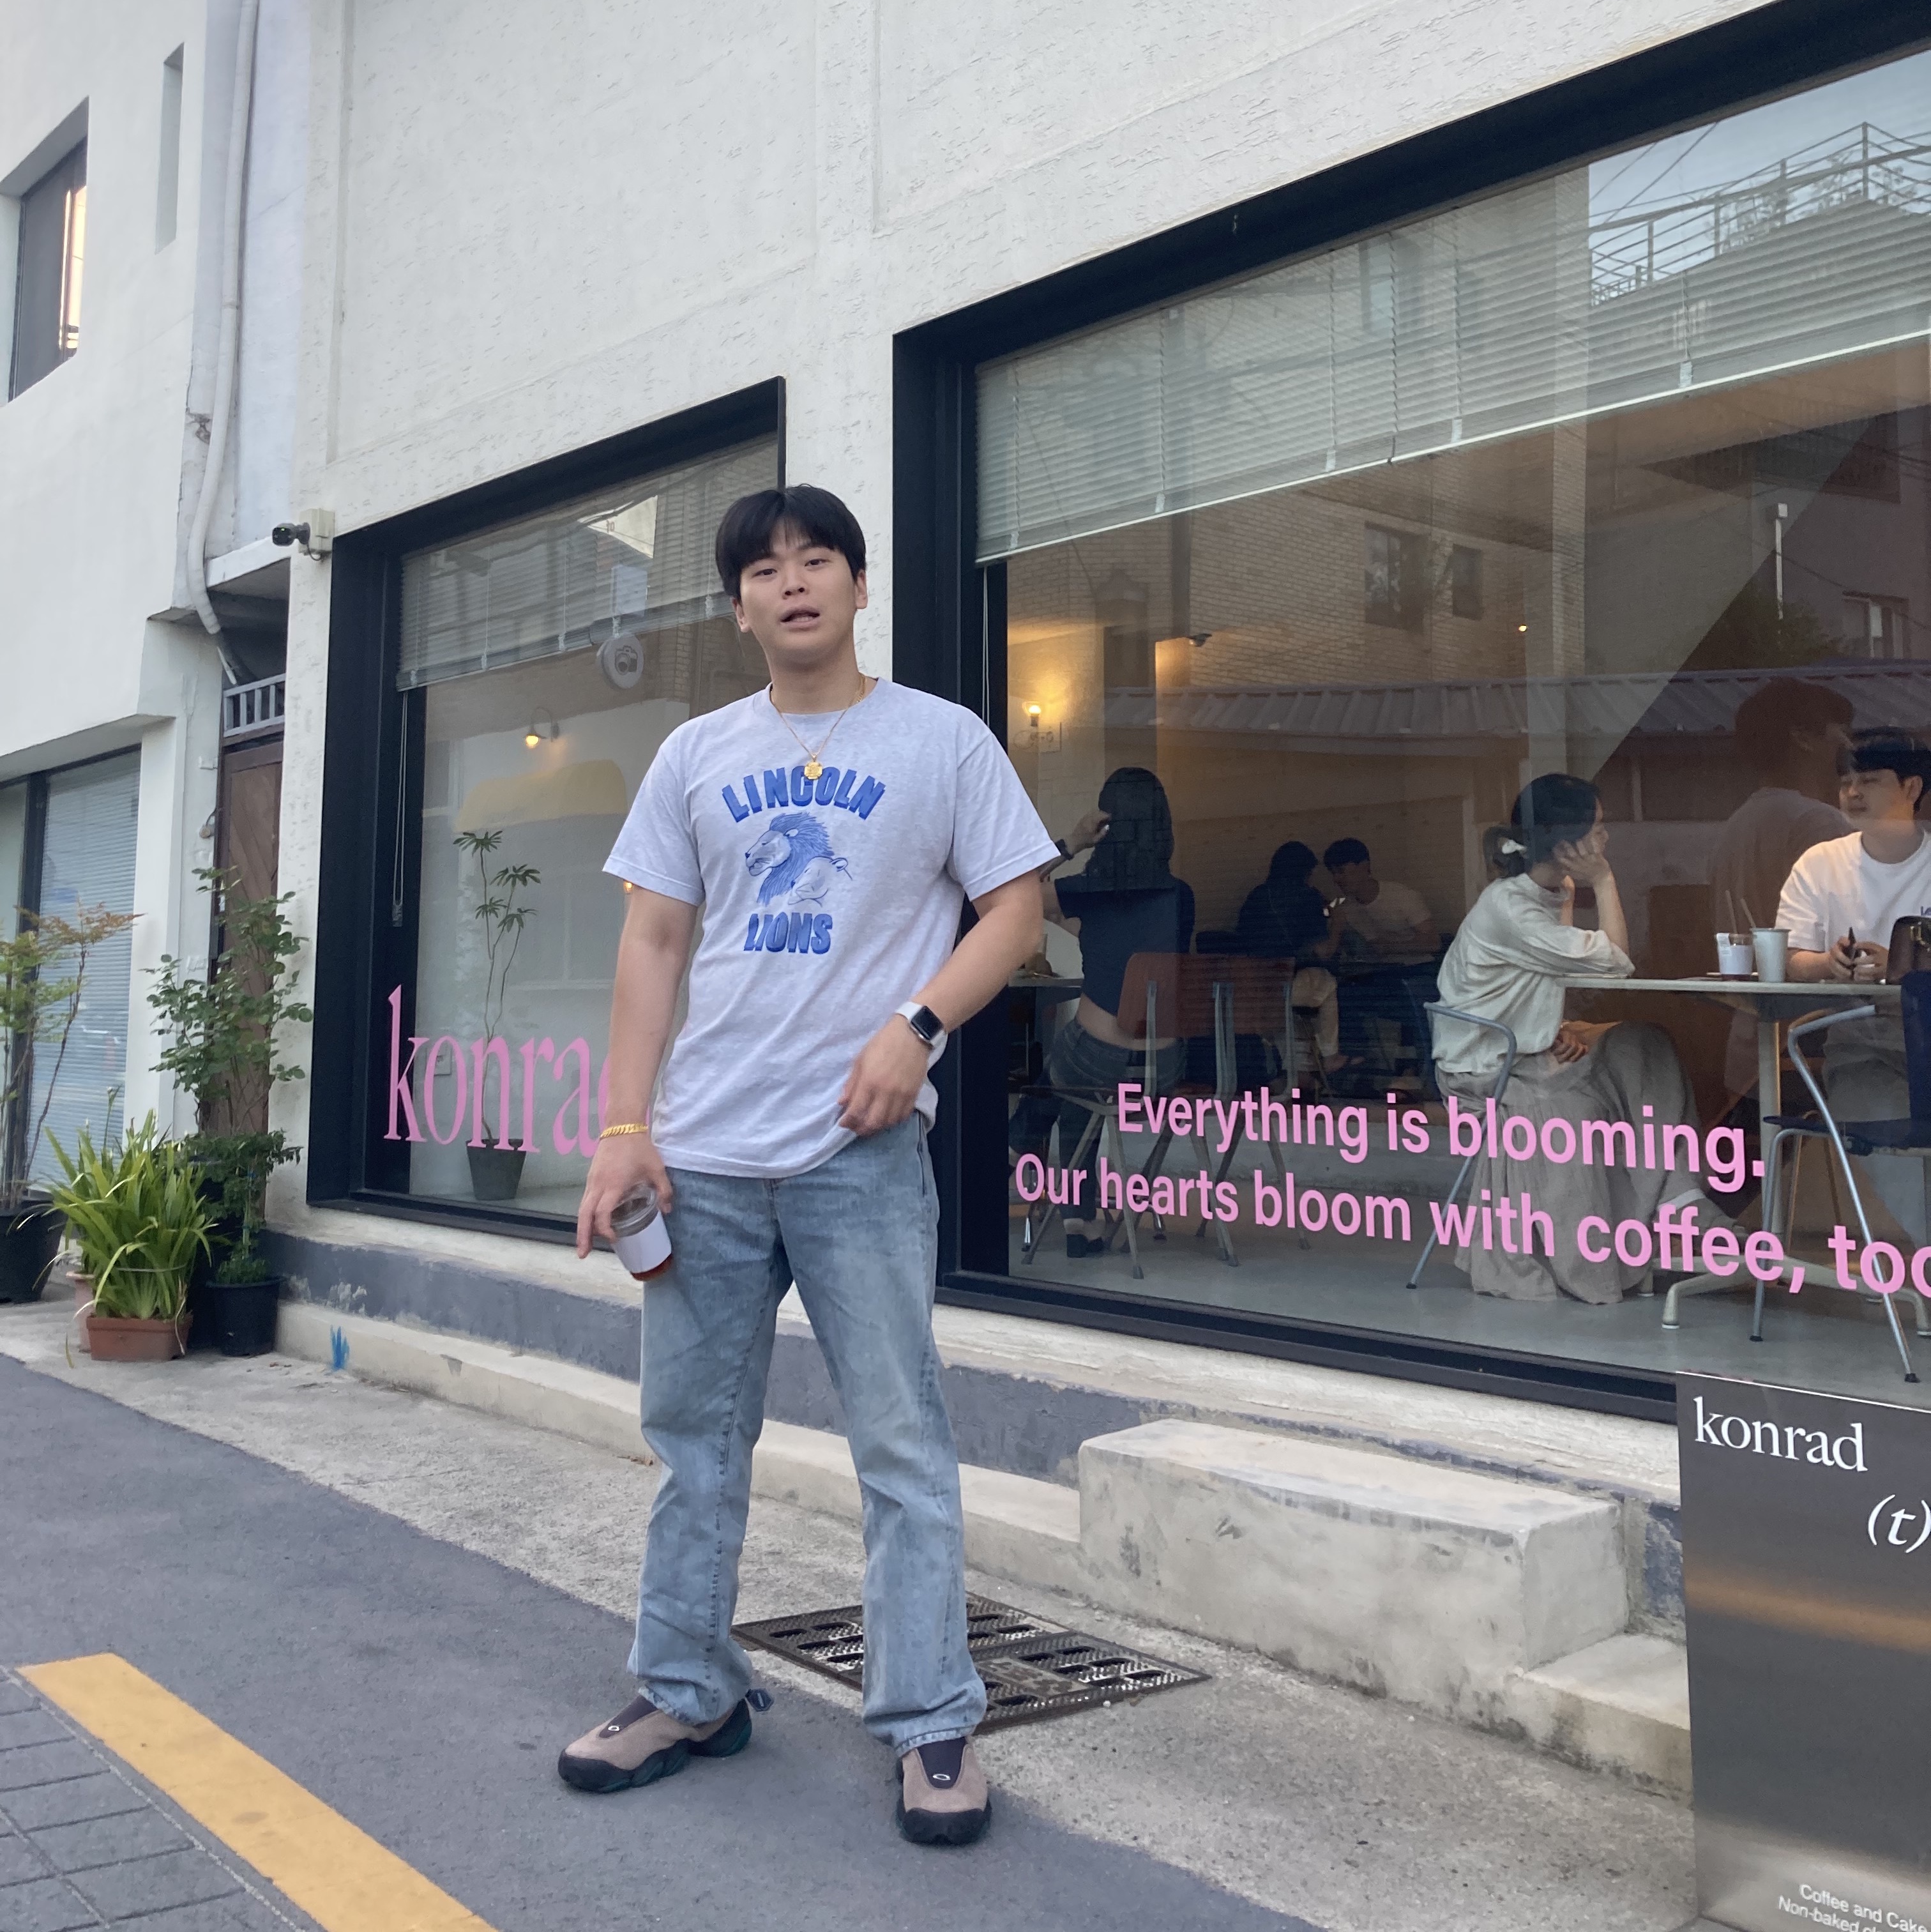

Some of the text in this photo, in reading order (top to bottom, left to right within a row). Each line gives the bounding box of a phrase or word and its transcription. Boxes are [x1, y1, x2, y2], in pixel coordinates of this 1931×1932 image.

[722, 766, 886, 823] LINCOLN
[743, 911, 833, 955] LIONS
[384, 984, 650, 1158] konra
[1118, 1083, 1765, 1193] Everything is blooming.
[1016, 1153, 1087, 1206] Our
[1100, 1157, 1239, 1222] hearts
[1254, 1169, 1411, 1241] bloom
[1430, 1189, 1555, 1257] with
[1577, 1203, 1805, 1294] coffee,
[1693, 1396, 1868, 1472] konrad
[1778, 1895, 1860, 1932] Non-baked
[1799, 1884, 1849, 1912] Coffee
[1853, 1903, 1882, 1923] and
